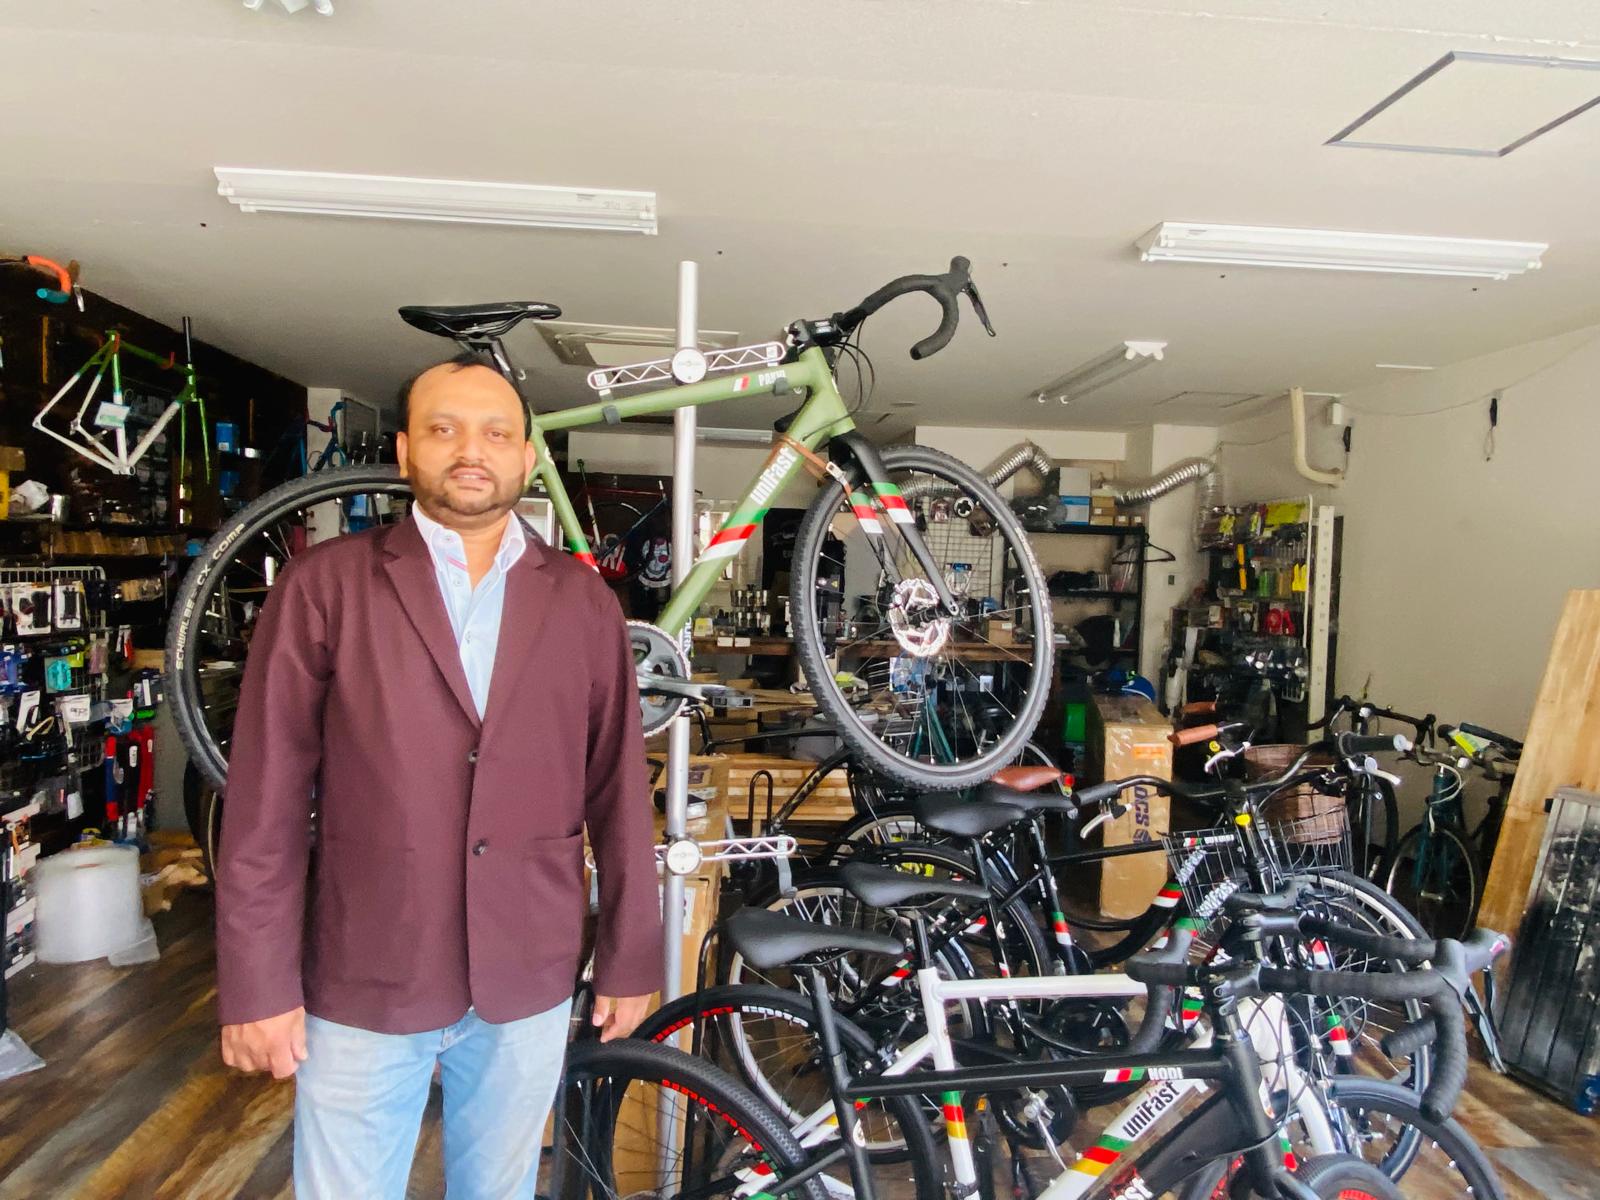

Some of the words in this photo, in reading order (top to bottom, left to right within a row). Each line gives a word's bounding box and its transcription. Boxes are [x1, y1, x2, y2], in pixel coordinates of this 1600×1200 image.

[175, 598, 196, 671] SCHWALBE
[196, 564, 212, 586] CX
[212, 523, 246, 561] COMP
[1122, 1081, 1180, 1138] uniFast
